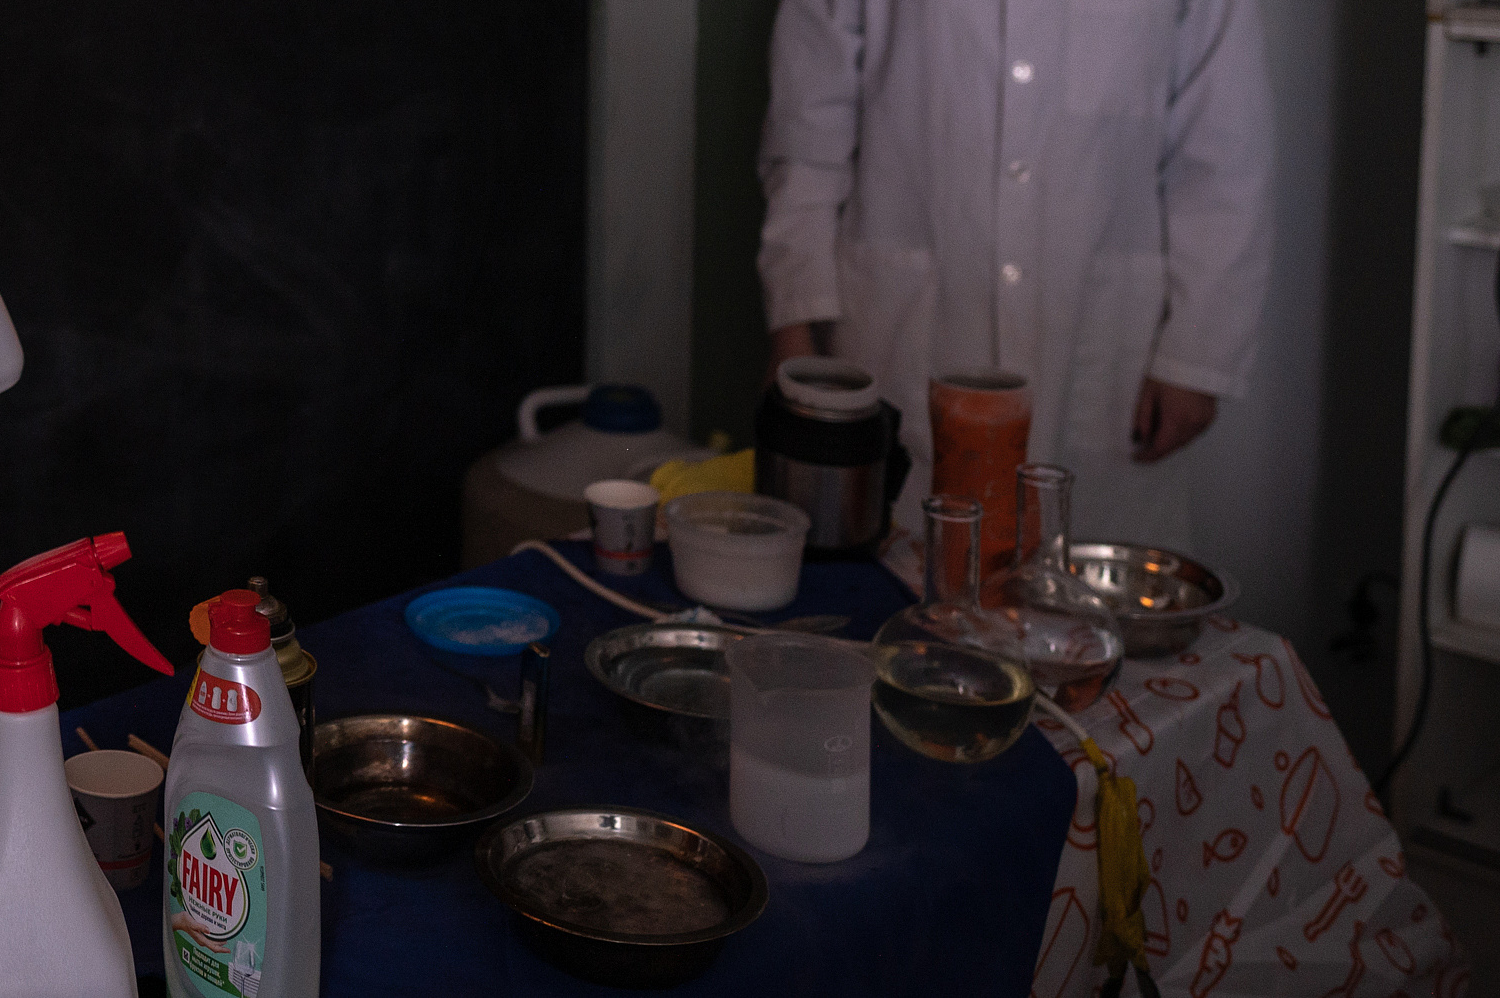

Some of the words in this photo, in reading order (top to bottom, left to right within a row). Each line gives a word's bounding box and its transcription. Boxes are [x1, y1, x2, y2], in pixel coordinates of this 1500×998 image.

[182, 849, 239, 917] FAIRY
[188, 895, 211, 915] НЕЖНЫЕ
[212, 911, 228, 924] РУКИ
